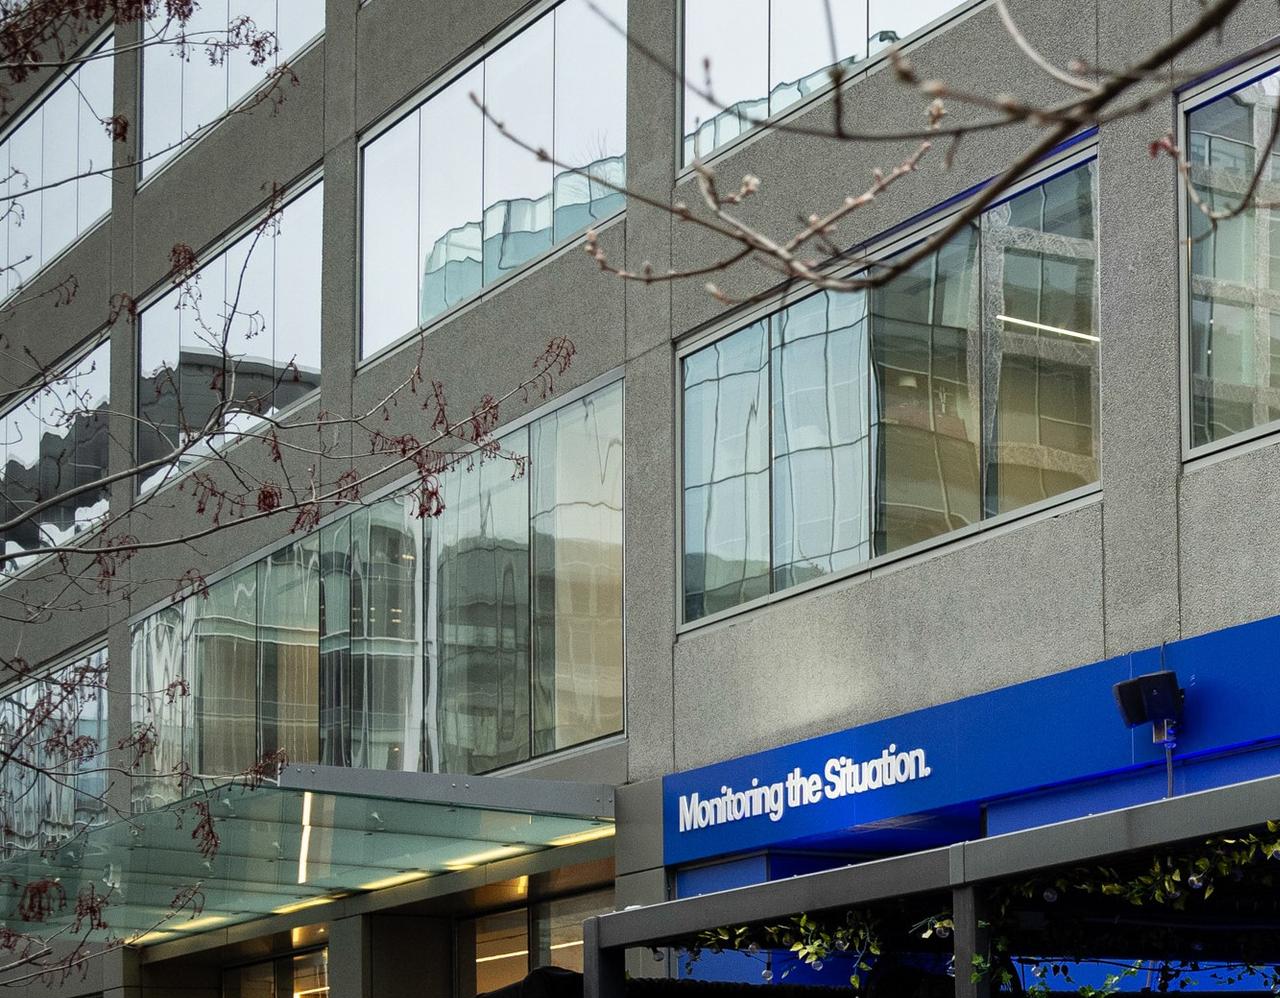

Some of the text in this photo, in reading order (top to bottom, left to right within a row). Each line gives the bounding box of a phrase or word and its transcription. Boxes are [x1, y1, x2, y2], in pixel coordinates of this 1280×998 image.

[679, 744, 931, 832] Monitoring the Situation.
